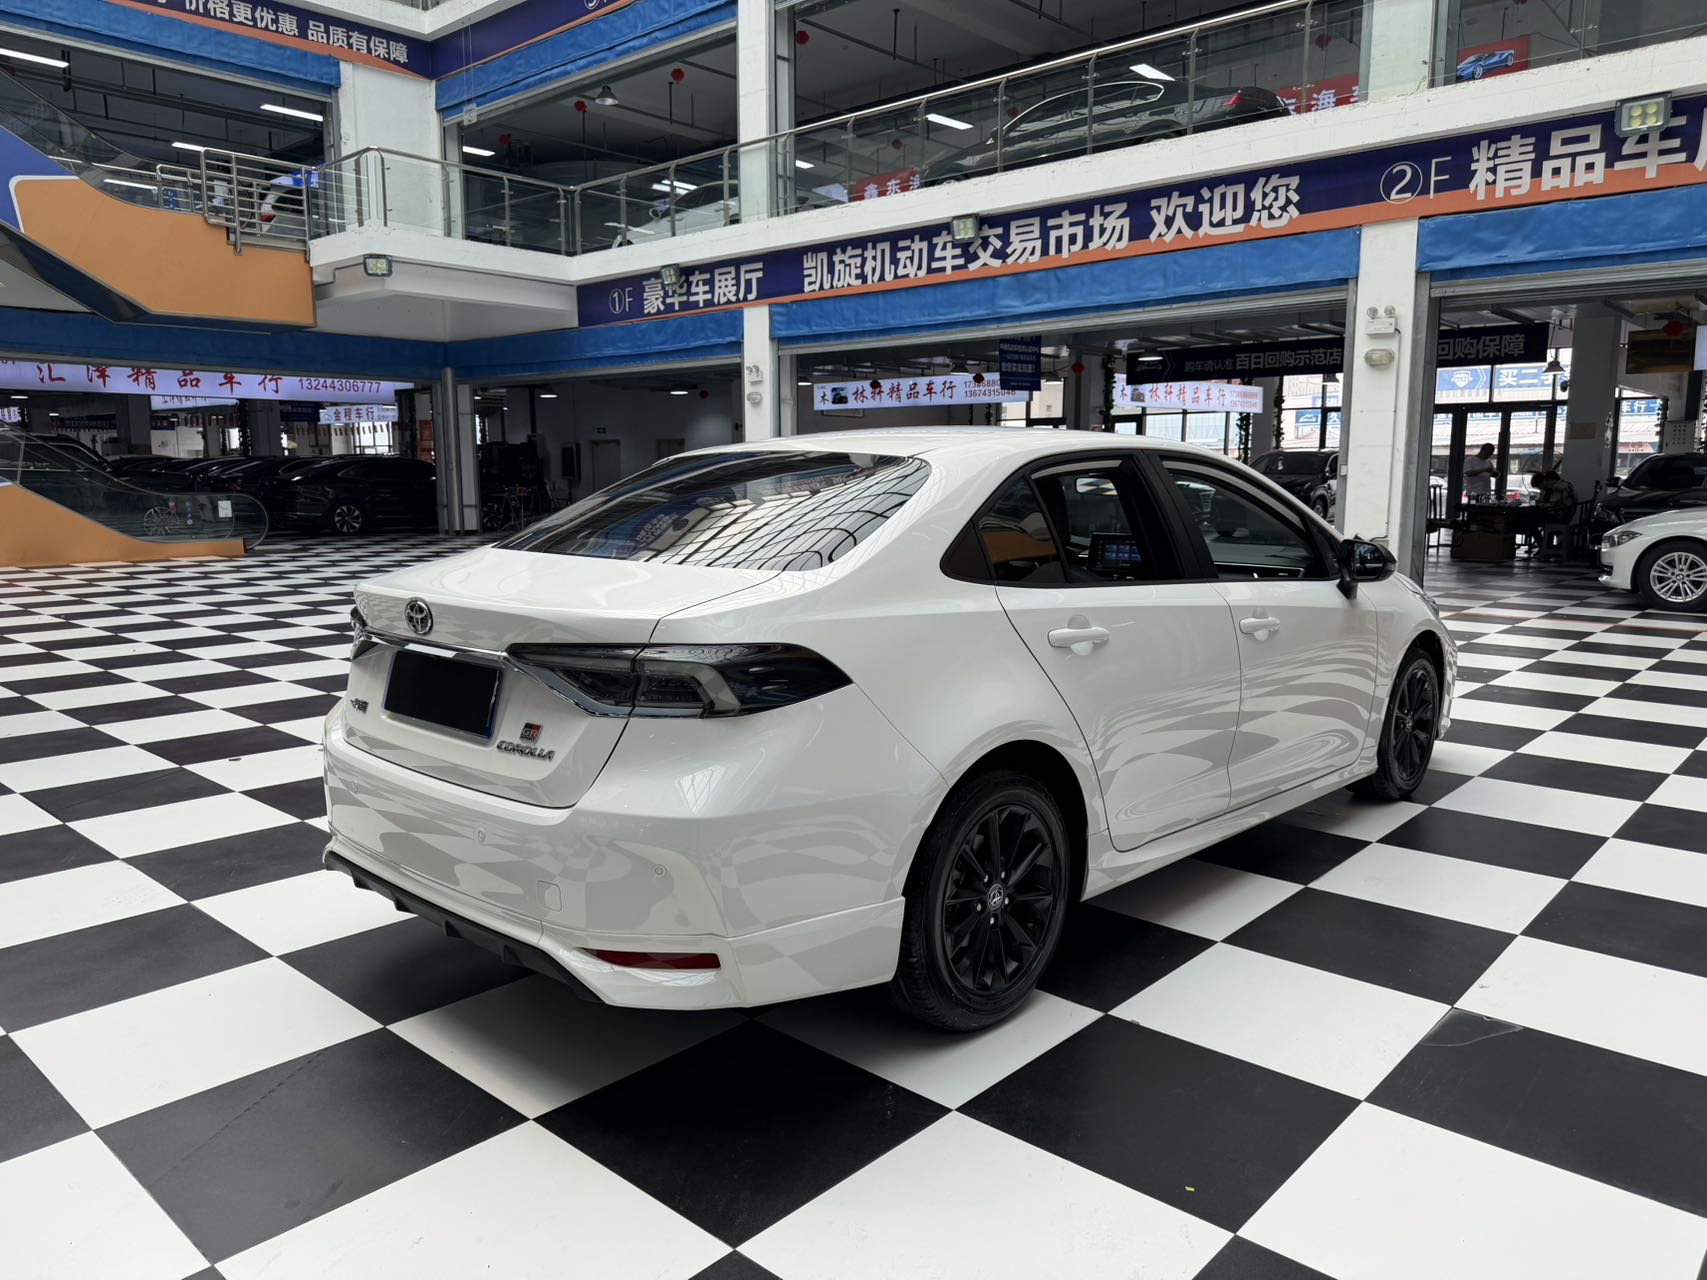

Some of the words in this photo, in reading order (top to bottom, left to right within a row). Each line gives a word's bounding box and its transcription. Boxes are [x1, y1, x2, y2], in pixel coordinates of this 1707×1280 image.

[308, 20, 408, 64] 品质有保障
[802, 202, 1130, 294] 凯旋机动车交易市场
[1149, 173, 1300, 244] 欢迎您
[642, 262, 764, 315] 豪华车展厅
[1235, 349, 1343, 370] 百日回购示范店
[1437, 333, 1526, 361] 回购保障
[298, 377, 381, 394] 13244306777
[496, 740, 556, 762] COROLLA
